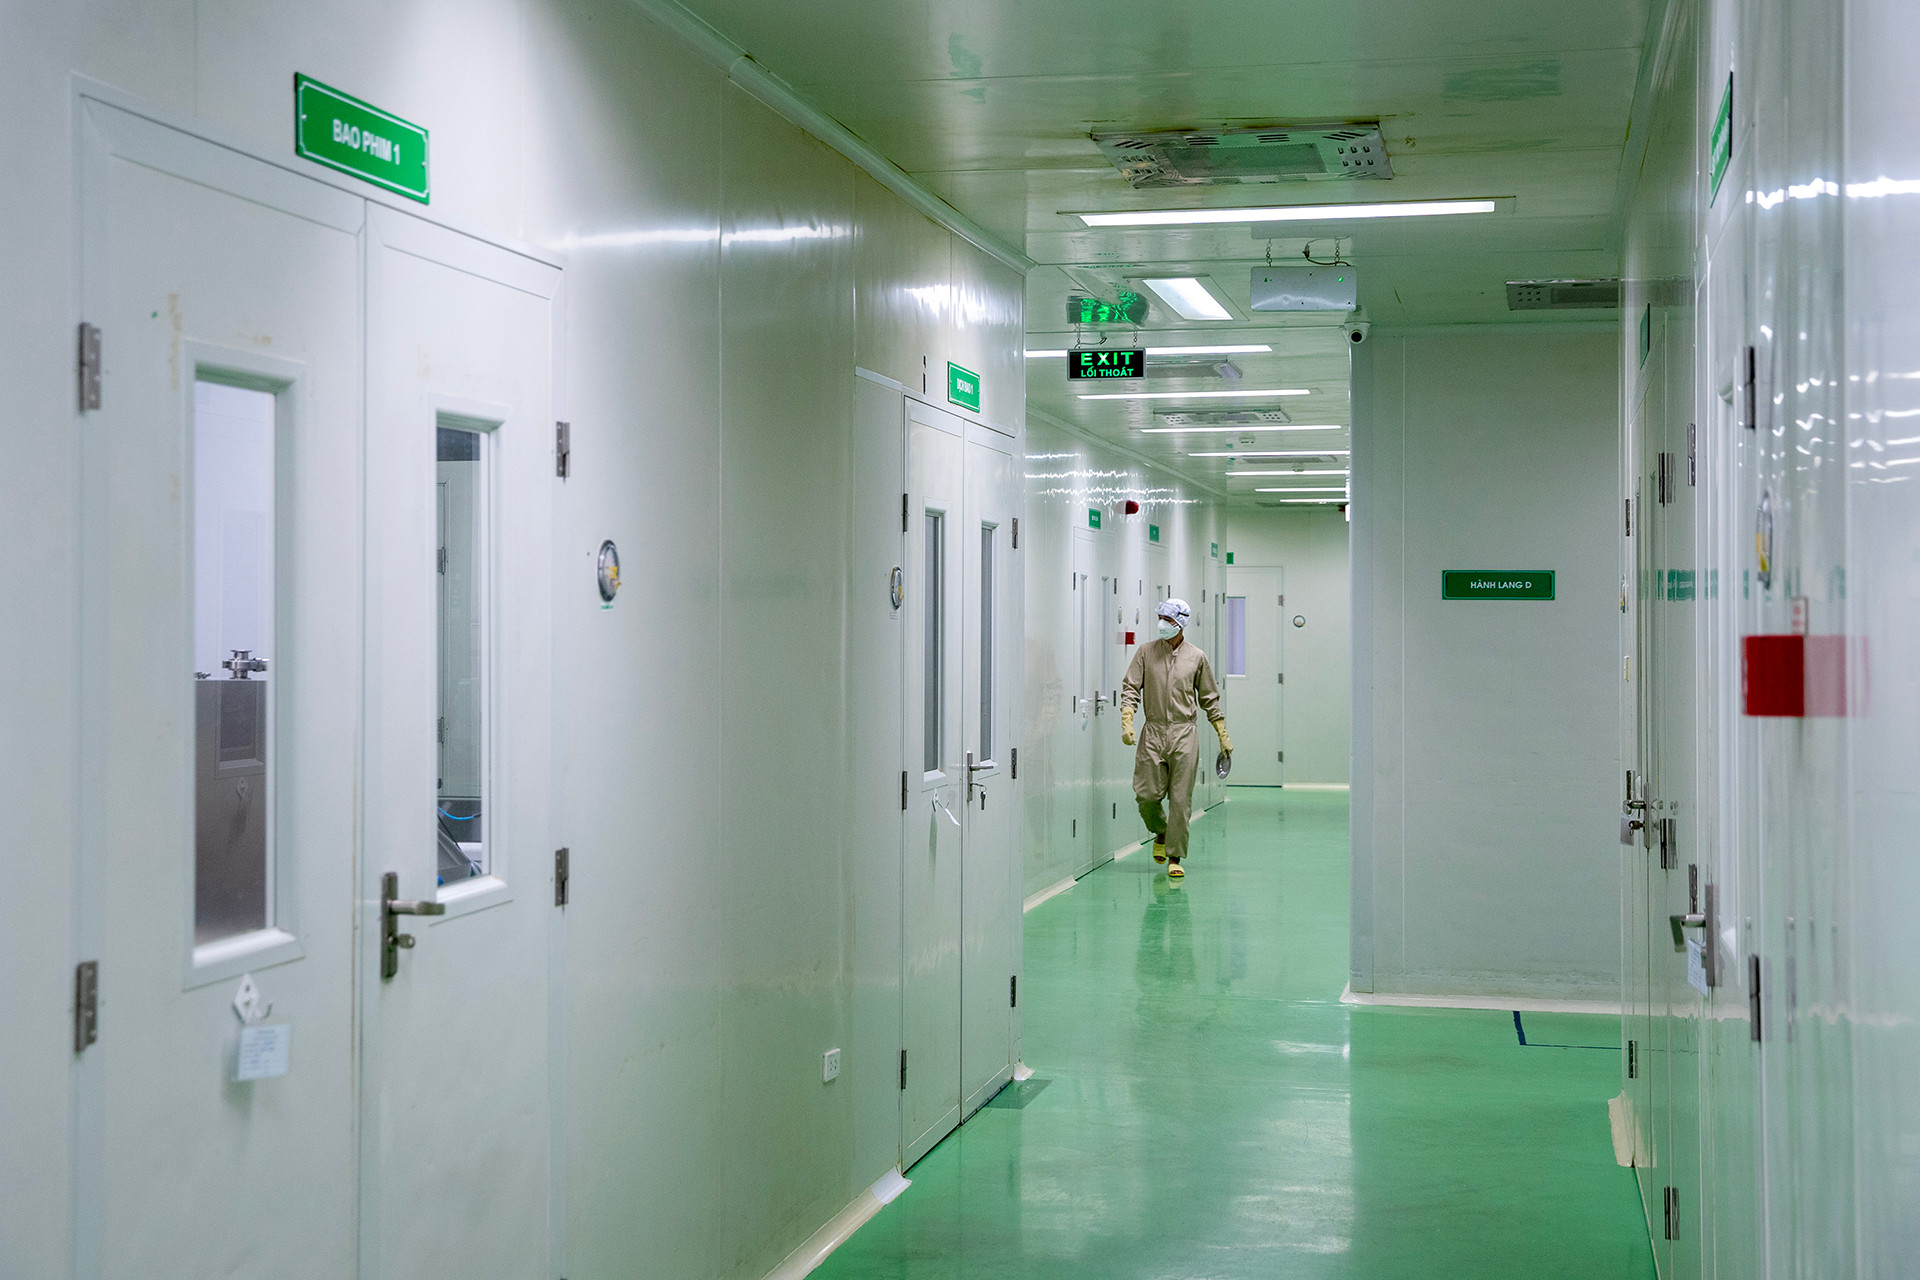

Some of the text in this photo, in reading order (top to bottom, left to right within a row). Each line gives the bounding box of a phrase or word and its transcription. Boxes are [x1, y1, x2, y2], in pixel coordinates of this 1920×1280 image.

[332, 118, 401, 166] BAO PHIM 1
[1080, 352, 1134, 366] EXIT
[1080, 366, 1134, 377] LỐI THOÁT
[1470, 579, 1532, 589] HÀNH LANG D
